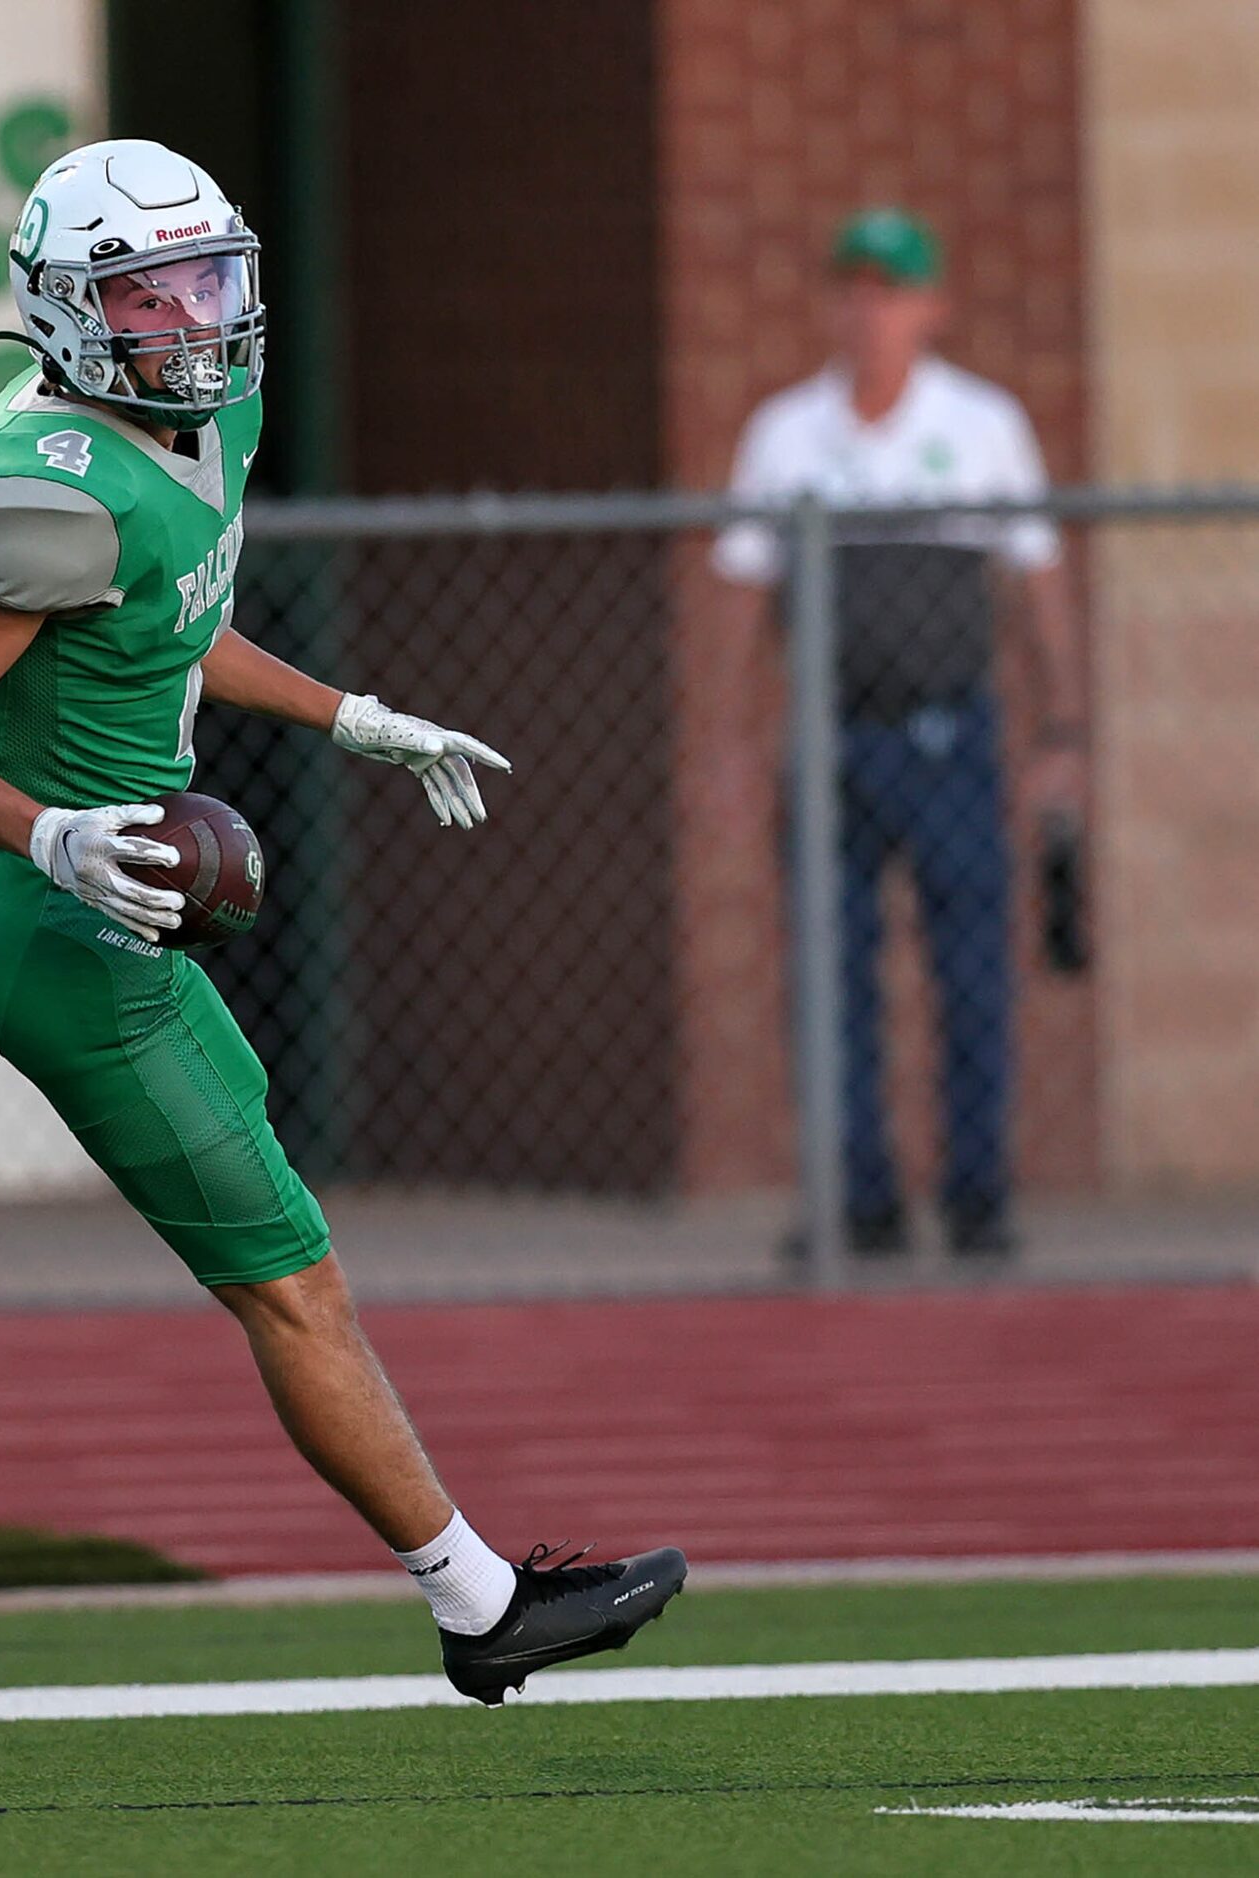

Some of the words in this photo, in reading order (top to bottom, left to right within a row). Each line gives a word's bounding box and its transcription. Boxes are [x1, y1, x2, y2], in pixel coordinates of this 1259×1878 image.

[155, 220, 212, 243] Riddell
[37, 429, 93, 478] 4
[96, 927, 128, 948] LAKE
